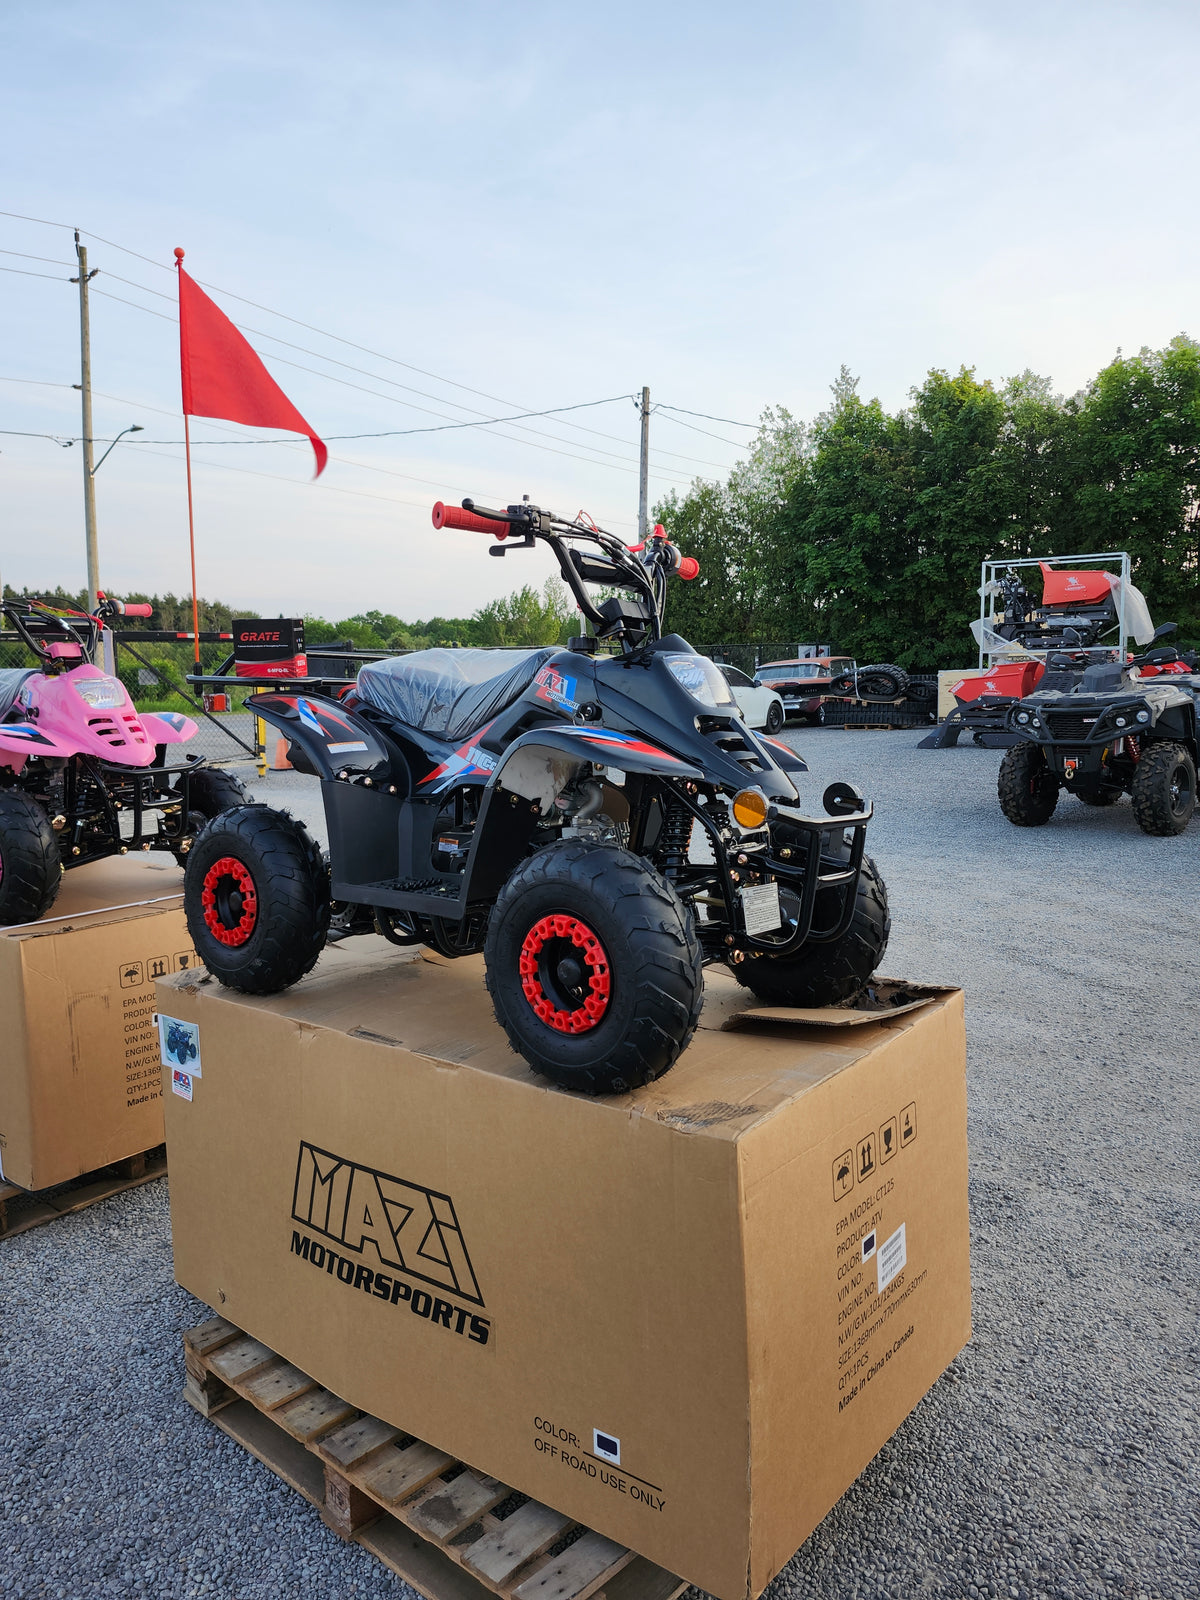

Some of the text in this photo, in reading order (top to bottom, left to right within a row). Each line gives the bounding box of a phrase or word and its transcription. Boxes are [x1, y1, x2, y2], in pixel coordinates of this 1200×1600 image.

[239, 631, 280, 642] GRATE
[122, 997, 138, 1008] EPA
[124, 1019, 152, 1033] COLOR:
[125, 1031, 155, 1045] VIN NO:
[125, 1045, 151, 1058] ENGINE
[126, 1064, 161, 1084] SIZE:1369
[127, 1077, 161, 1096] QTY:1PCS
[127, 1095, 149, 1108] Made
[150, 1092, 157, 1101] in
[835, 1215, 849, 1236] EPA
[836, 1222, 870, 1259] PRODUCT:
[870, 1208, 884, 1229] ATV
[836, 1250, 862, 1281] COLOR:
[290, 1230, 491, 1346] MOTORSPORTS
[837, 1272, 864, 1303] VIN NO:
[837, 1280, 877, 1326] ENGINE NO:
[838, 1324, 915, 1414] Made in China to Canada
[838, 1350, 869, 1391] QTY:1PCS
[534, 1415, 581, 1449] COLOR:
[534, 1437, 666, 1512] OFF ROAD USE ONLY
